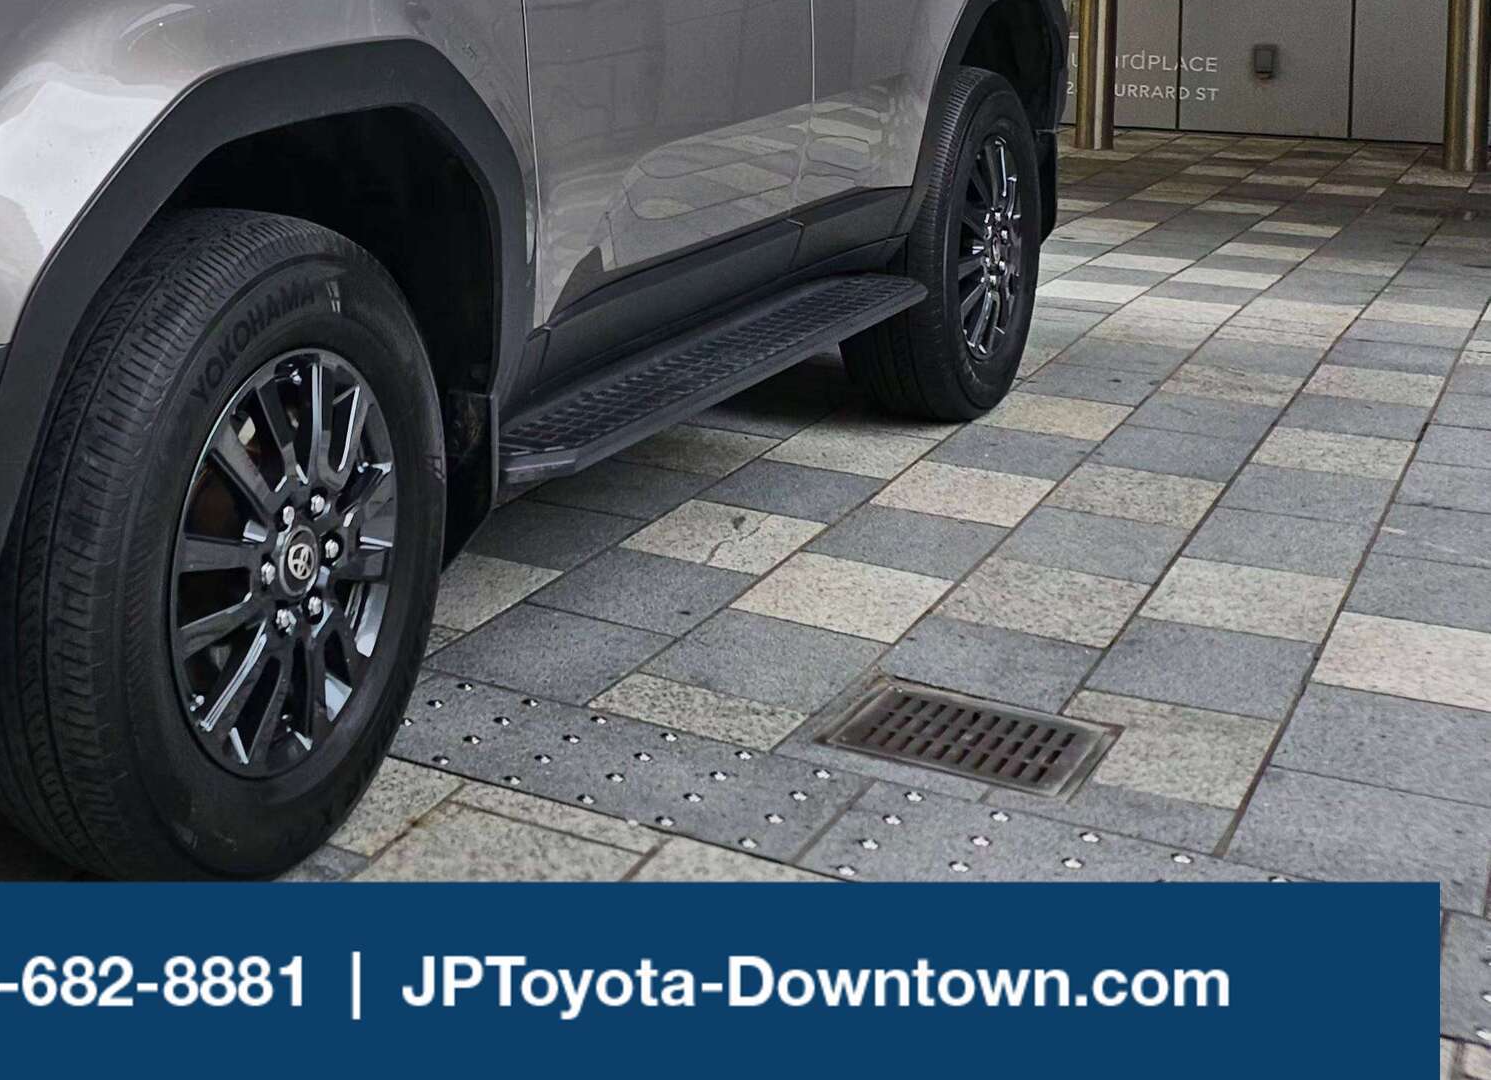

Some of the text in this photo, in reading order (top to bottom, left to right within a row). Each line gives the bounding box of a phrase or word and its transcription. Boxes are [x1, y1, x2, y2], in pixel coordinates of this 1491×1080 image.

[1114, 83, 1220, 102] URRARD ST
[190, 276, 317, 401] YOKOHAMA
